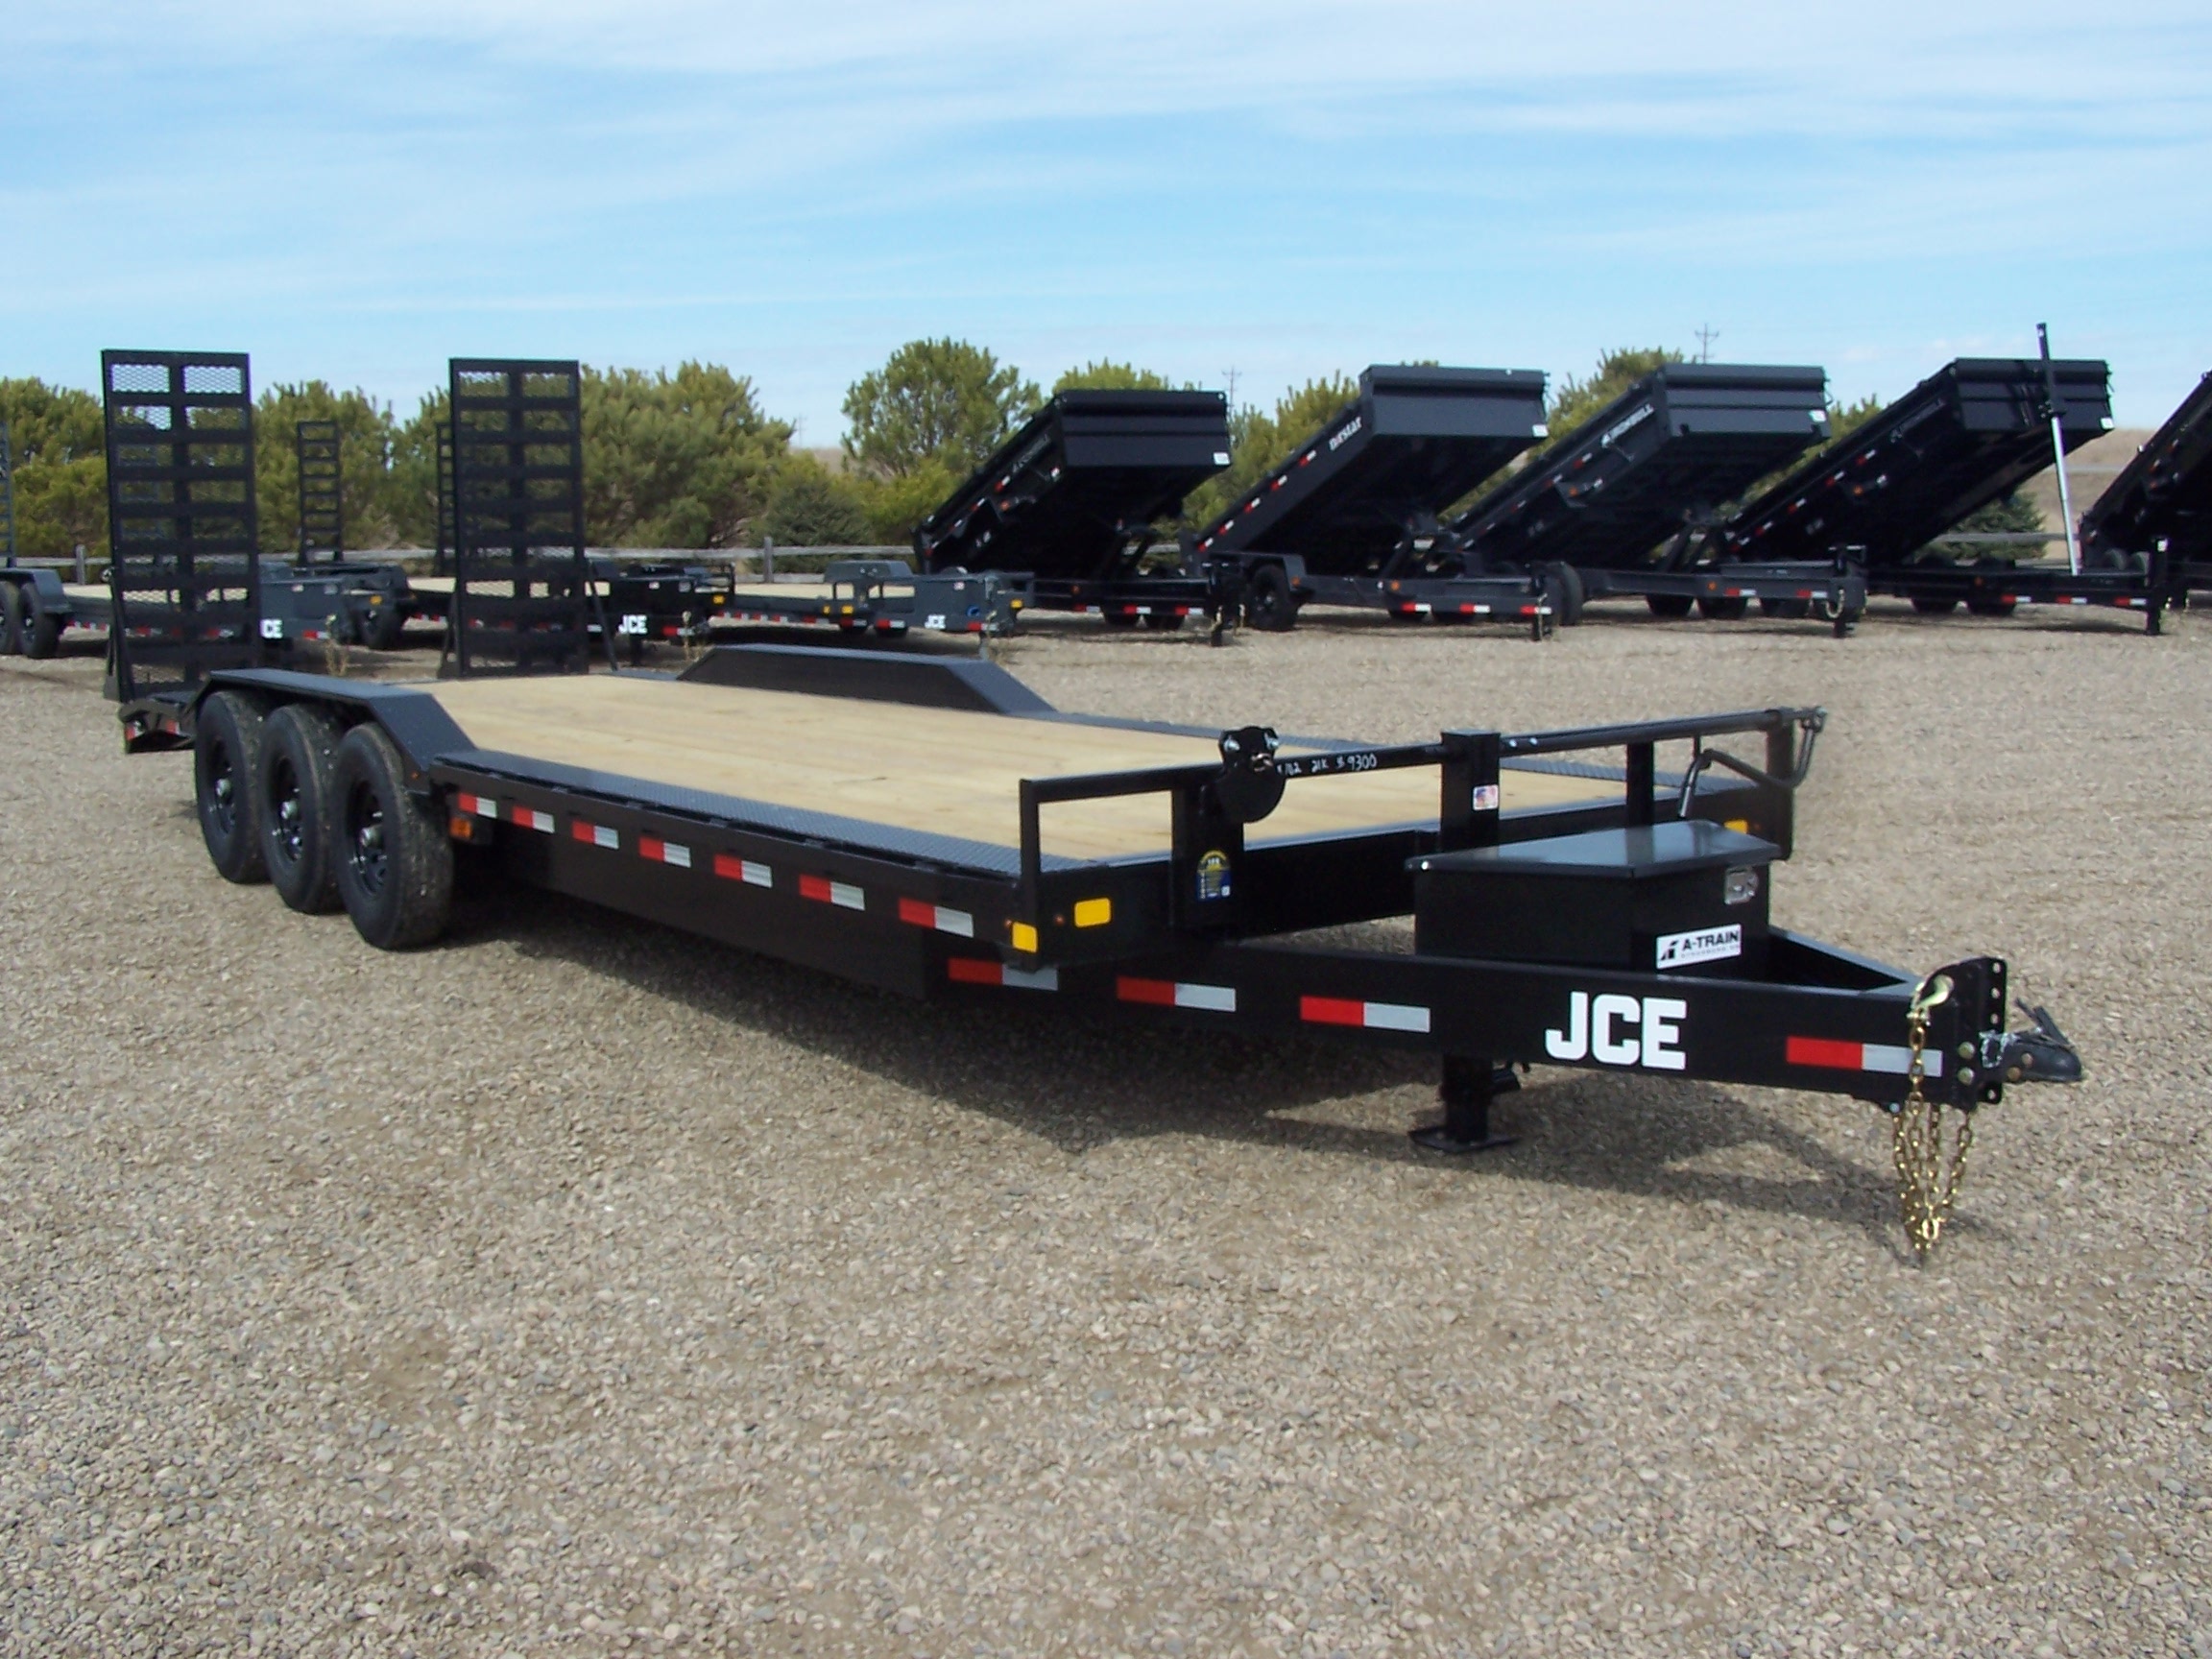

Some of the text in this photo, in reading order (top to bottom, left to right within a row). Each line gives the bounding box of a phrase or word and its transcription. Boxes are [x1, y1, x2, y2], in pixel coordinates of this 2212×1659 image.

[259, 619, 283, 638] CE
[617, 614, 648, 635] JCE
[924, 614, 947, 631] JCE
[1681, 930, 1739, 951] A-TRAIN
[1545, 991, 1688, 1070] JCE
